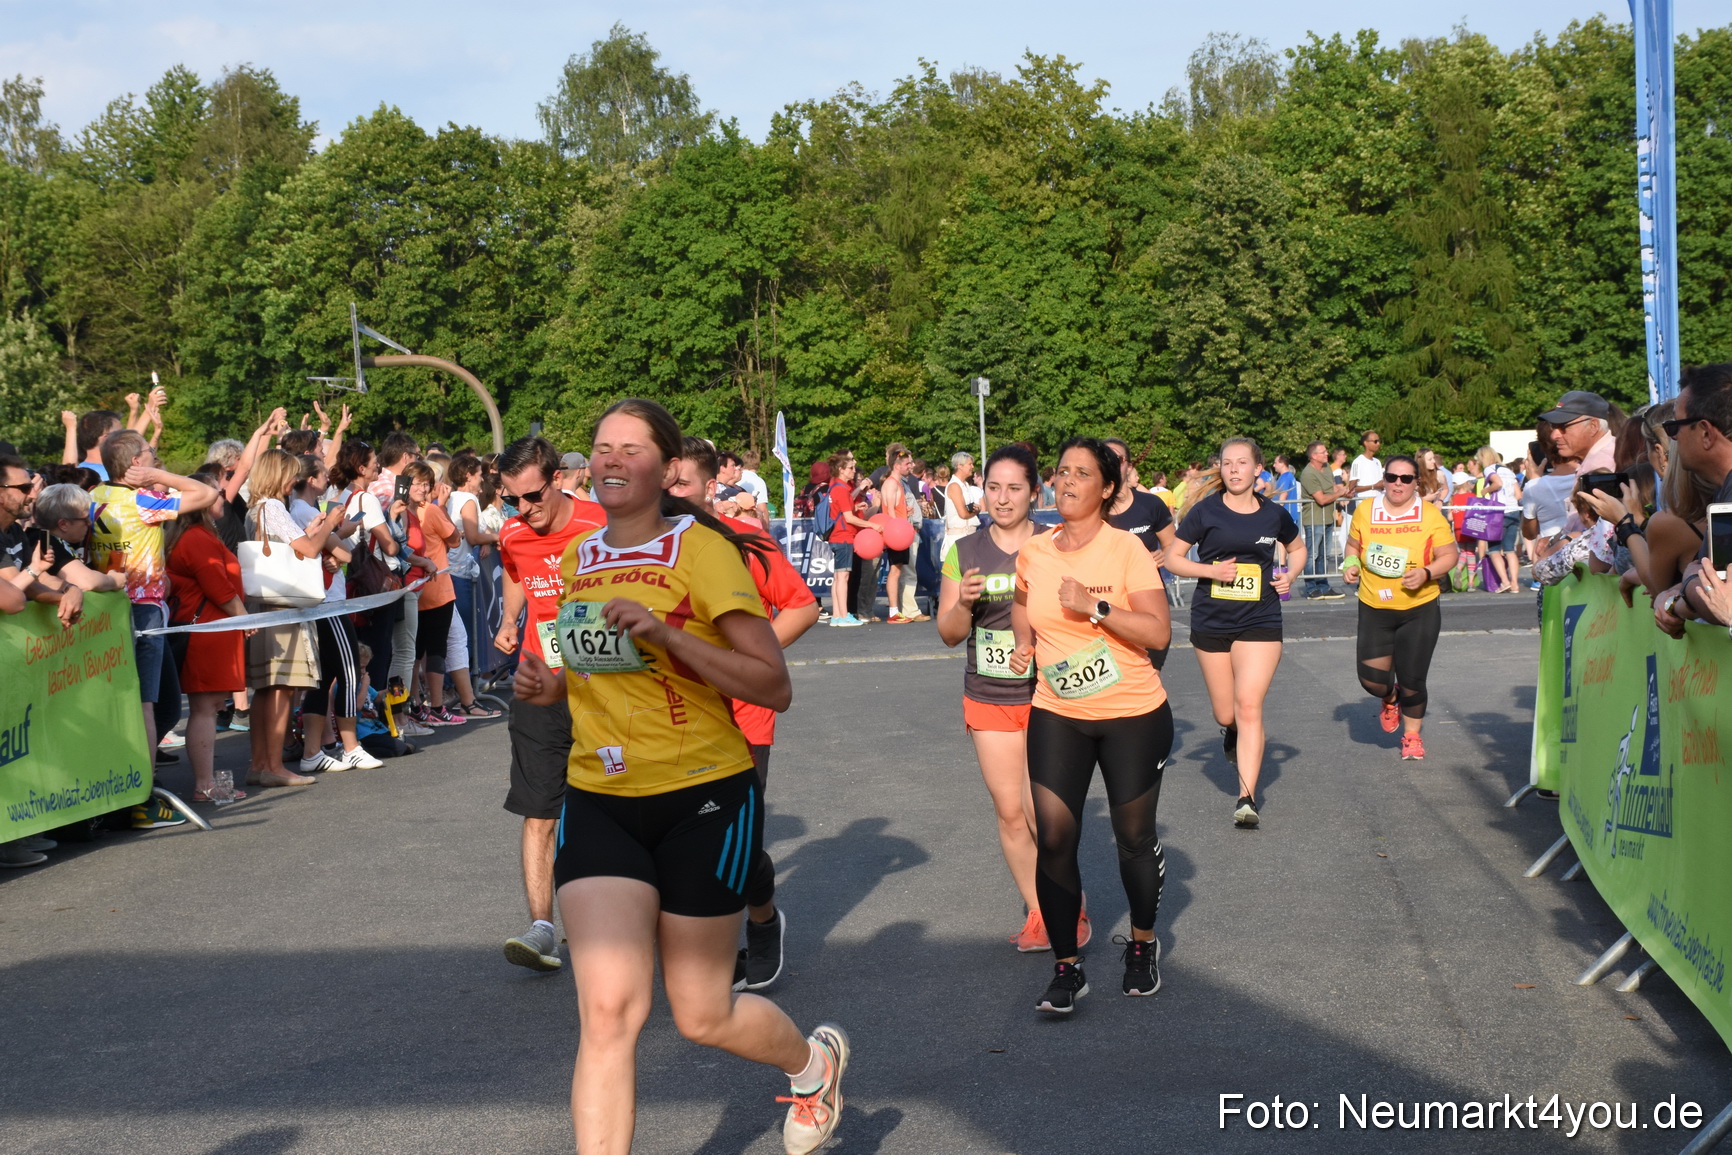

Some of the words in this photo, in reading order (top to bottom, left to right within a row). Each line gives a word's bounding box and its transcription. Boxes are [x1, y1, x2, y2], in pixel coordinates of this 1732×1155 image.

[1370, 527, 1392, 535] MAX
[1395, 525, 1422, 534] BÖGL
[1370, 553, 1401, 570] 1565
[568, 577, 604, 596] MAX
[610, 568, 671, 590] BÖGL
[1085, 585, 1114, 594] HULE
[533, 589, 557, 598] IMMER
[78, 611, 113, 643] Firmen
[566, 629, 621, 656] 1627
[48, 656, 83, 697] laufen
[84, 634, 128, 683] länger!
[1056, 658, 1110, 691] 2302
[698, 806, 721, 815] adidas
